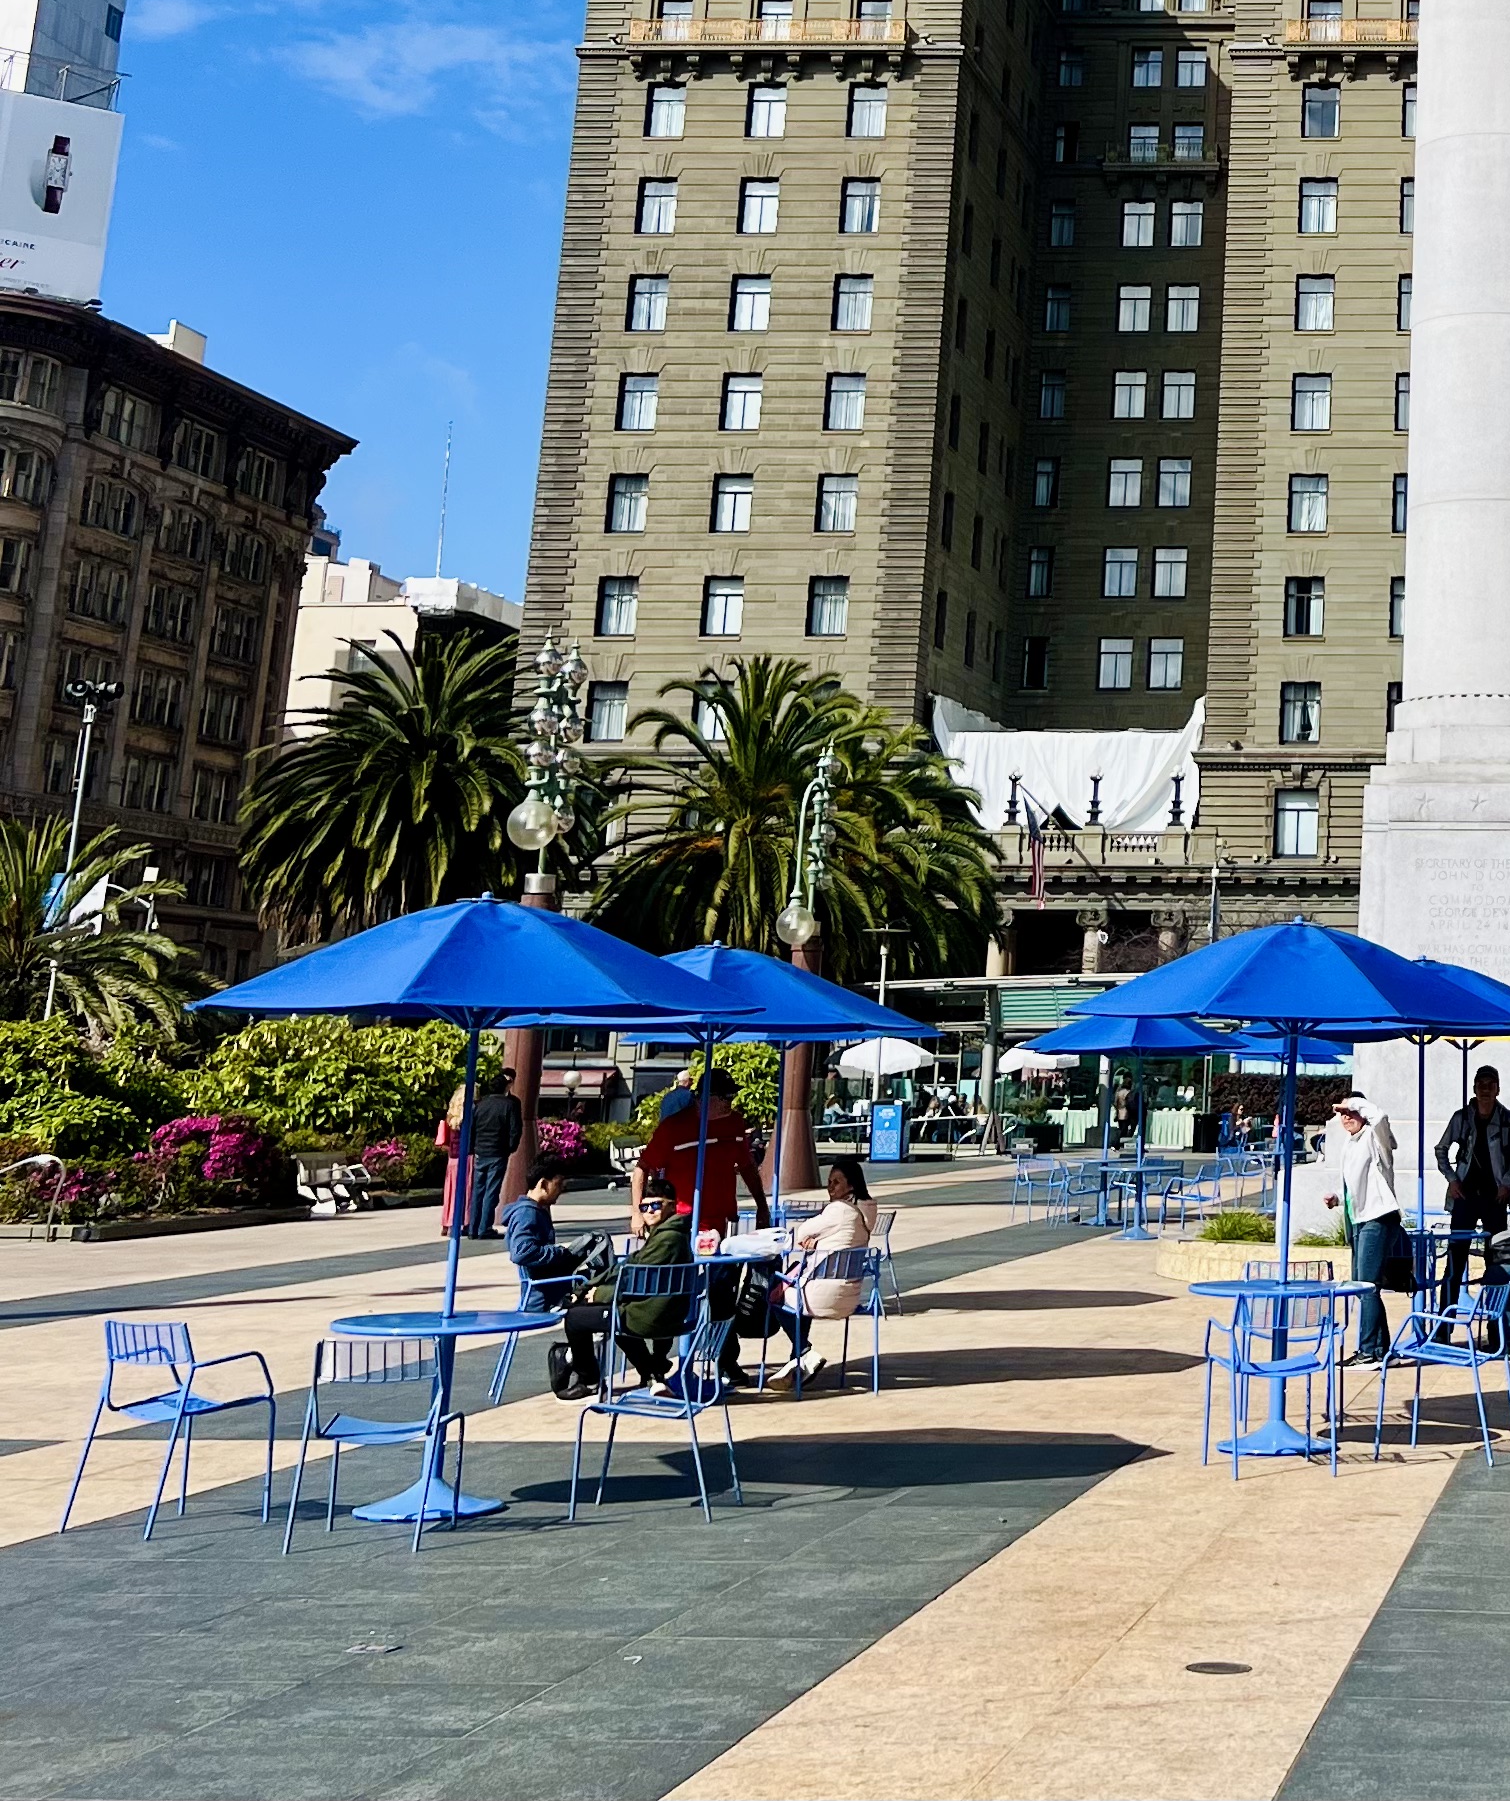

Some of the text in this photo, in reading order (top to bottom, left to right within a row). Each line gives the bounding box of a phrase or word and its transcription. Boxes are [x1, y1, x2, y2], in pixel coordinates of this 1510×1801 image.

[1415, 858, 1471, 869] SECRETARY
[1473, 859, 1487, 868] OF
[1490, 858, 1510, 869] THE
[1430, 870, 1469, 881] JOHN
[1471, 883, 1484, 892] TO
[1428, 907, 1477, 918] GEORGE
[1429, 919, 1470, 930] APRIL
[1469, 956, 1489, 967] THE
